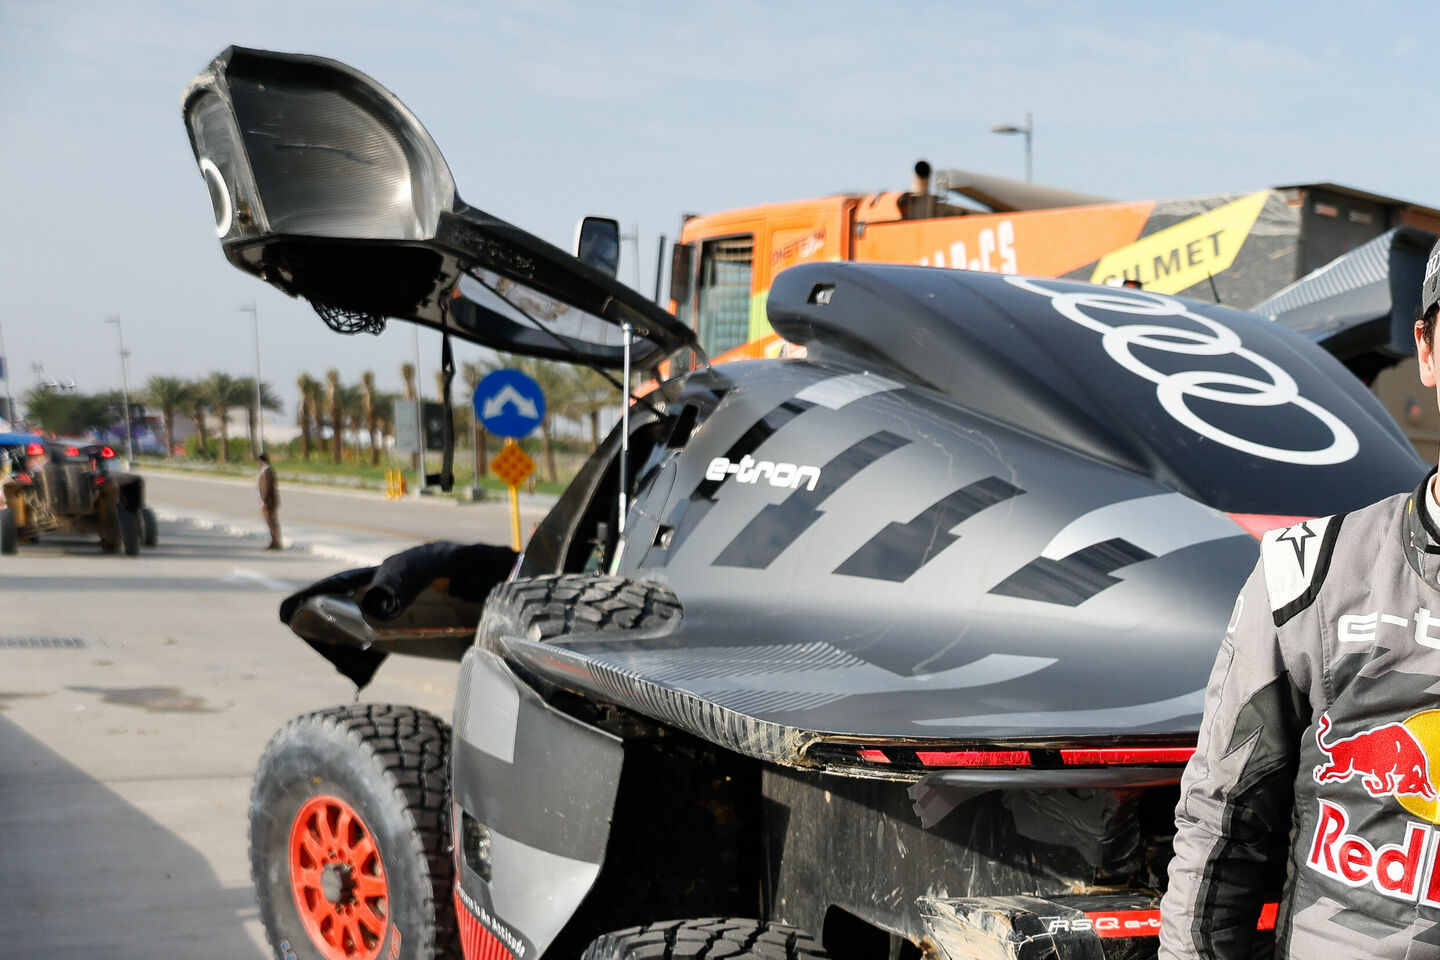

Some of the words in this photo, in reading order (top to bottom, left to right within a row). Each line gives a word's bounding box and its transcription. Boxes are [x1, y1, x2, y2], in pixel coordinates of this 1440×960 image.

[705, 454, 821, 491] e-tron
[1306, 798, 1432, 902] Red
[492, 917, 526, 958] Attitude
[1124, 918, 1161, 928] e-t
